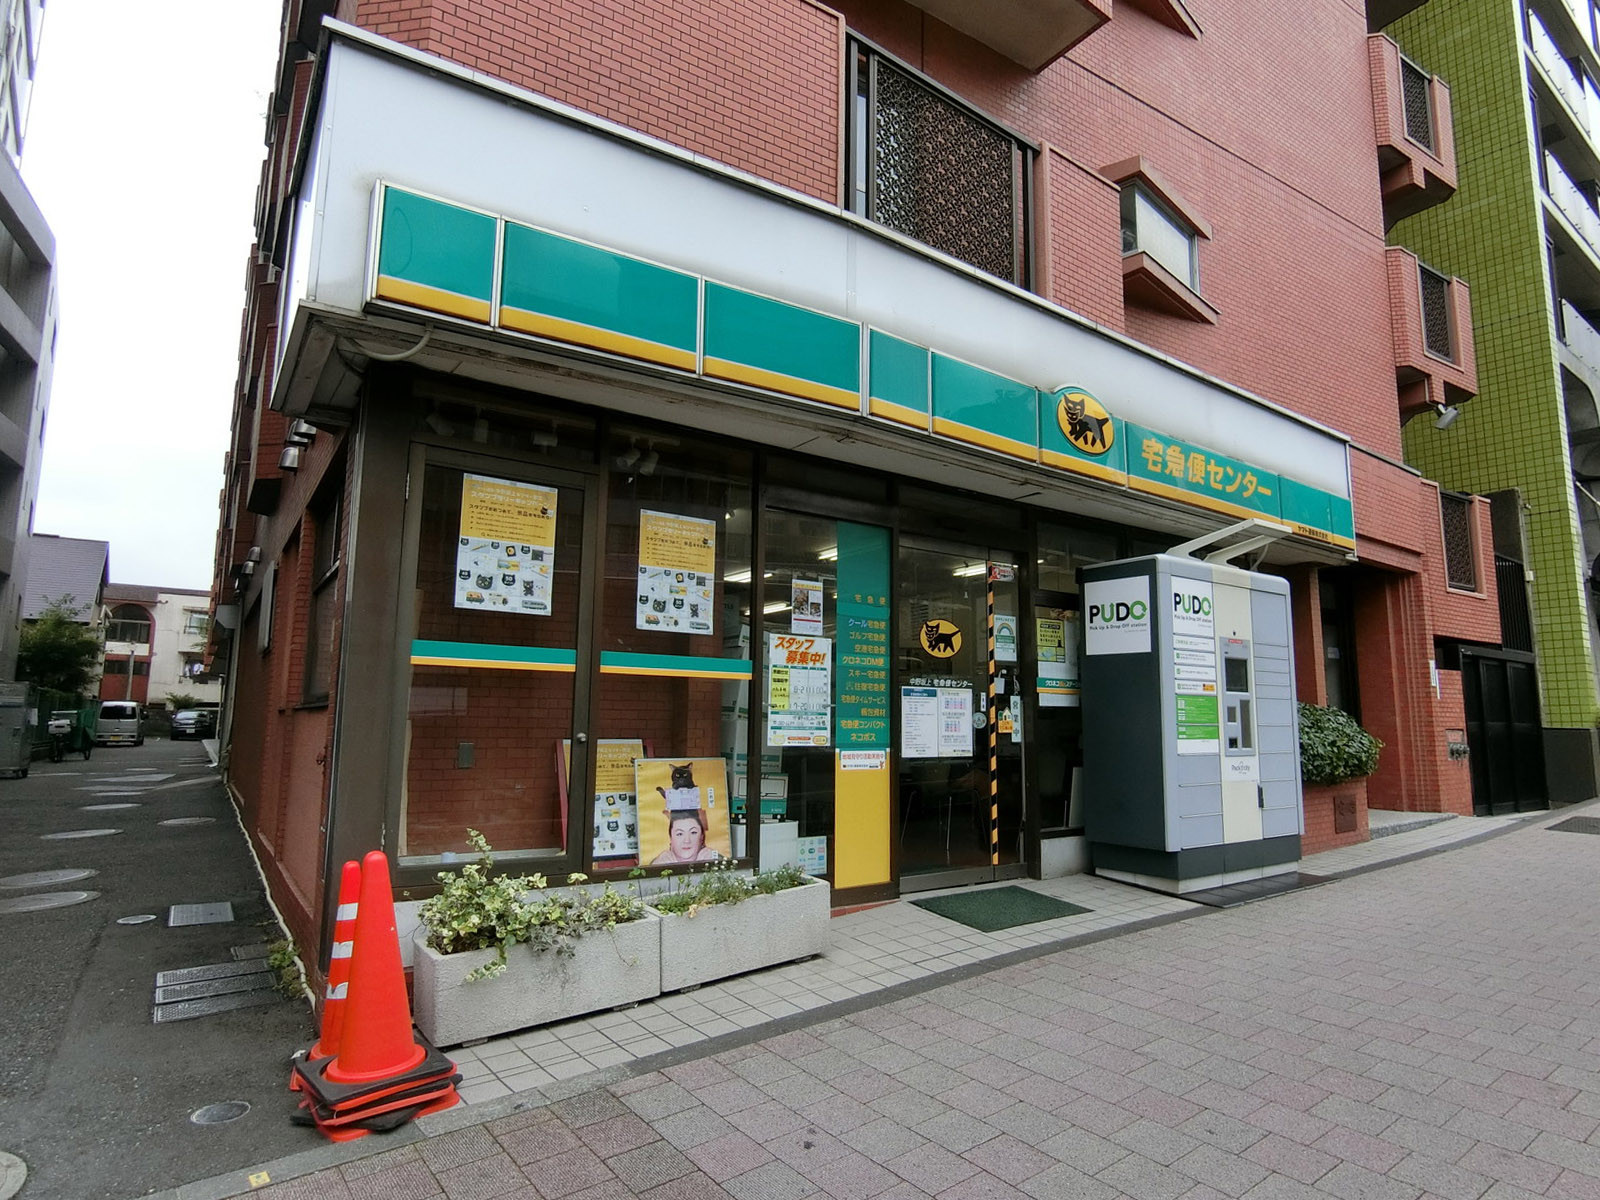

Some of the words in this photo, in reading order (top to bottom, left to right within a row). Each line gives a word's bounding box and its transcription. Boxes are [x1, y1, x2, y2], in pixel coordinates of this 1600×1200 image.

[1141, 437, 1272, 498] 宅急便センター
[1089, 600, 1148, 624] PUDO
[1173, 592, 1212, 616] PUDO
[774, 636, 815, 650] スタッフ
[850, 733, 876, 741] ネコポス
